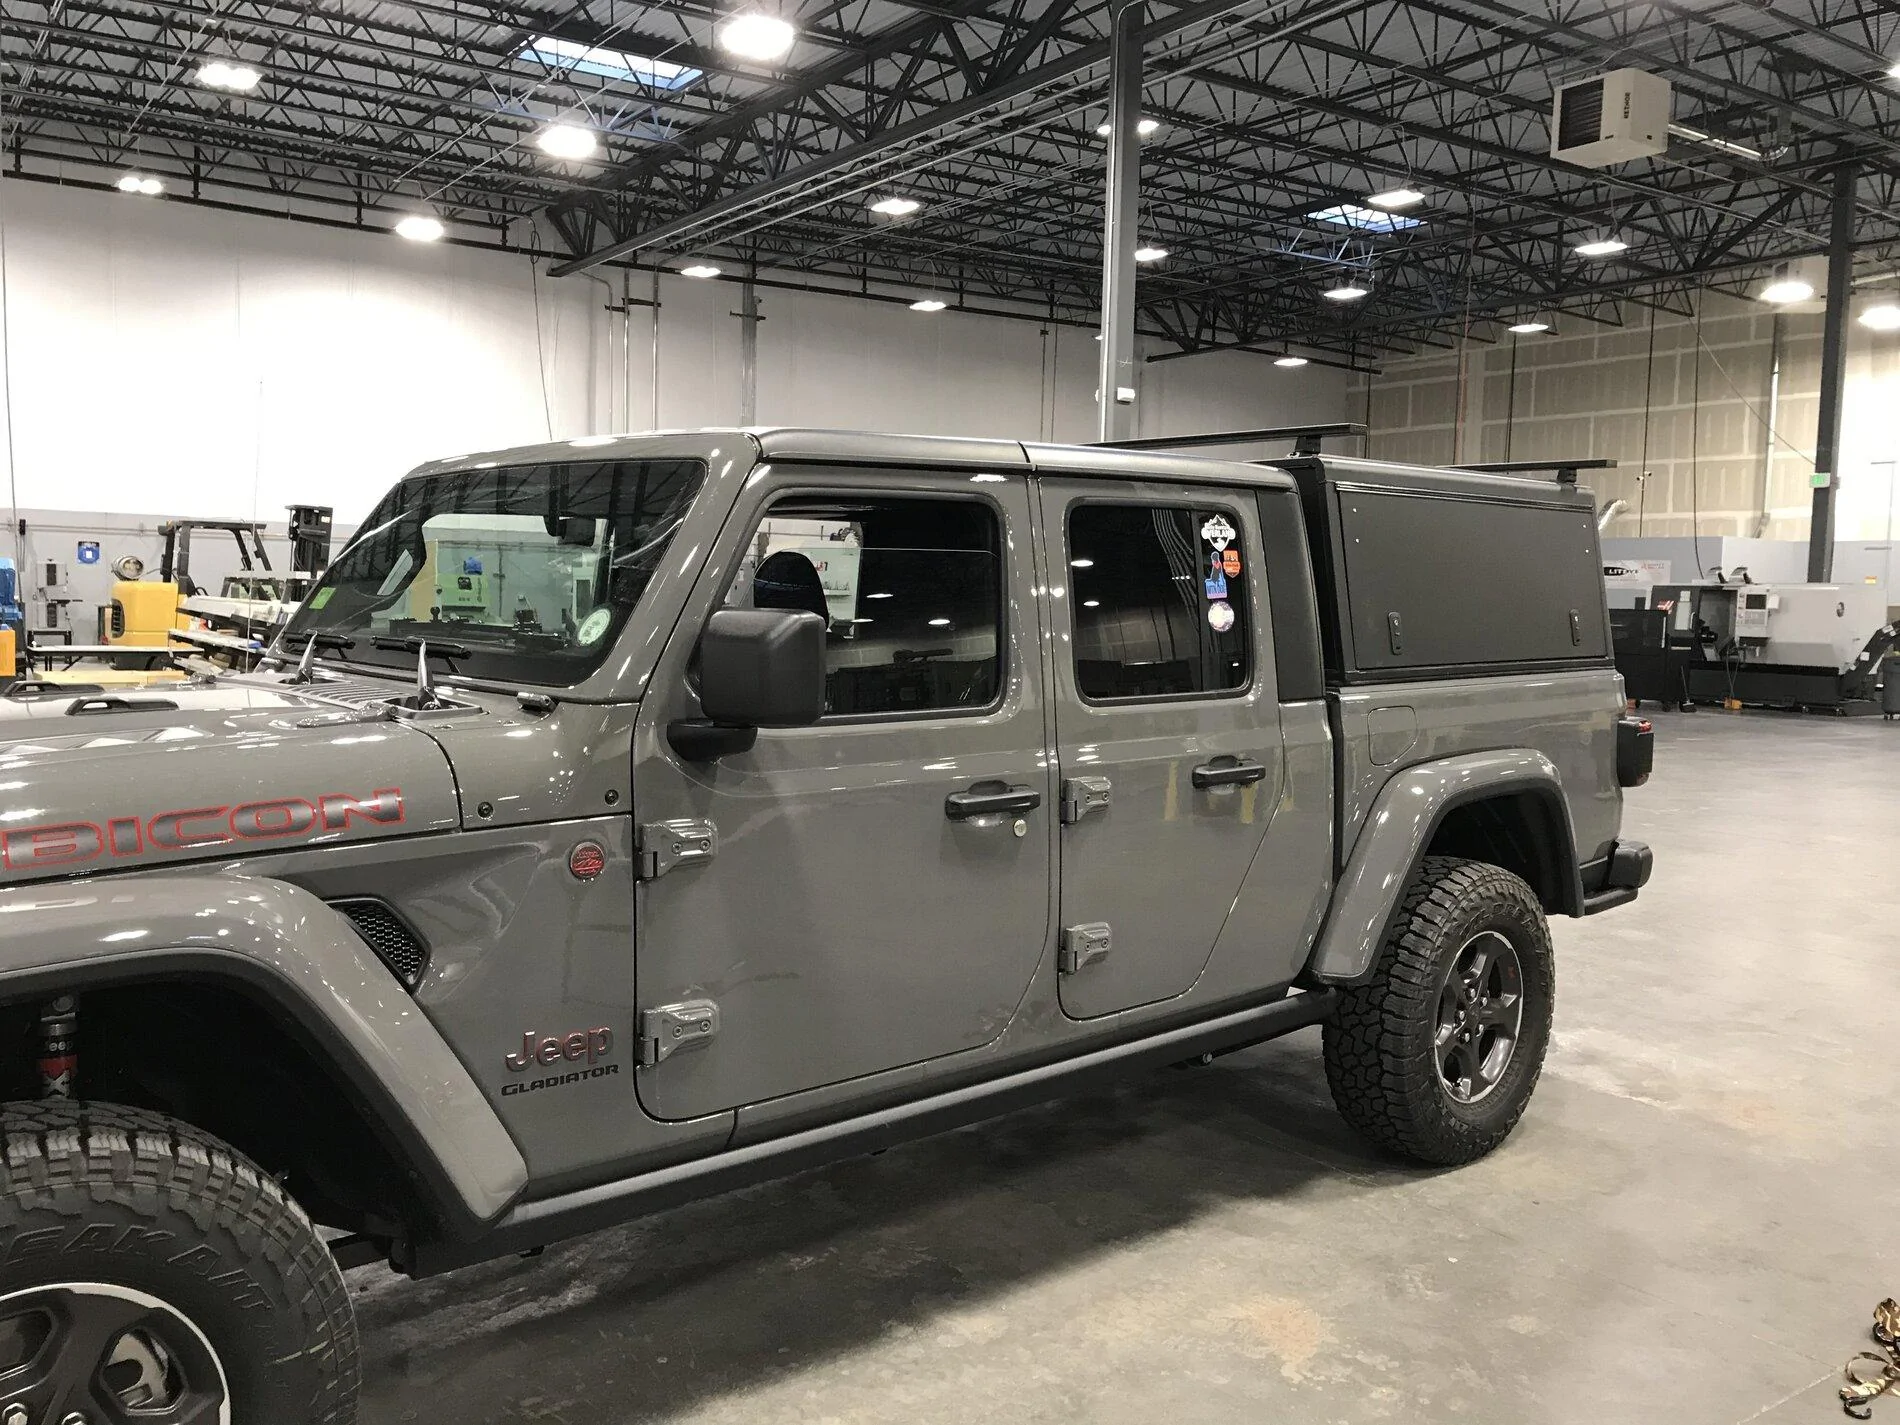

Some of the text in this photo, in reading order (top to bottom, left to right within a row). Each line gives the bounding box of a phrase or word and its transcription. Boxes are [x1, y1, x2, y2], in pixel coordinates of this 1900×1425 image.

[0, 786, 403, 869] BICON
[507, 1027, 614, 1072] Jeep
[501, 1064, 619, 1096] GLADIATOR
